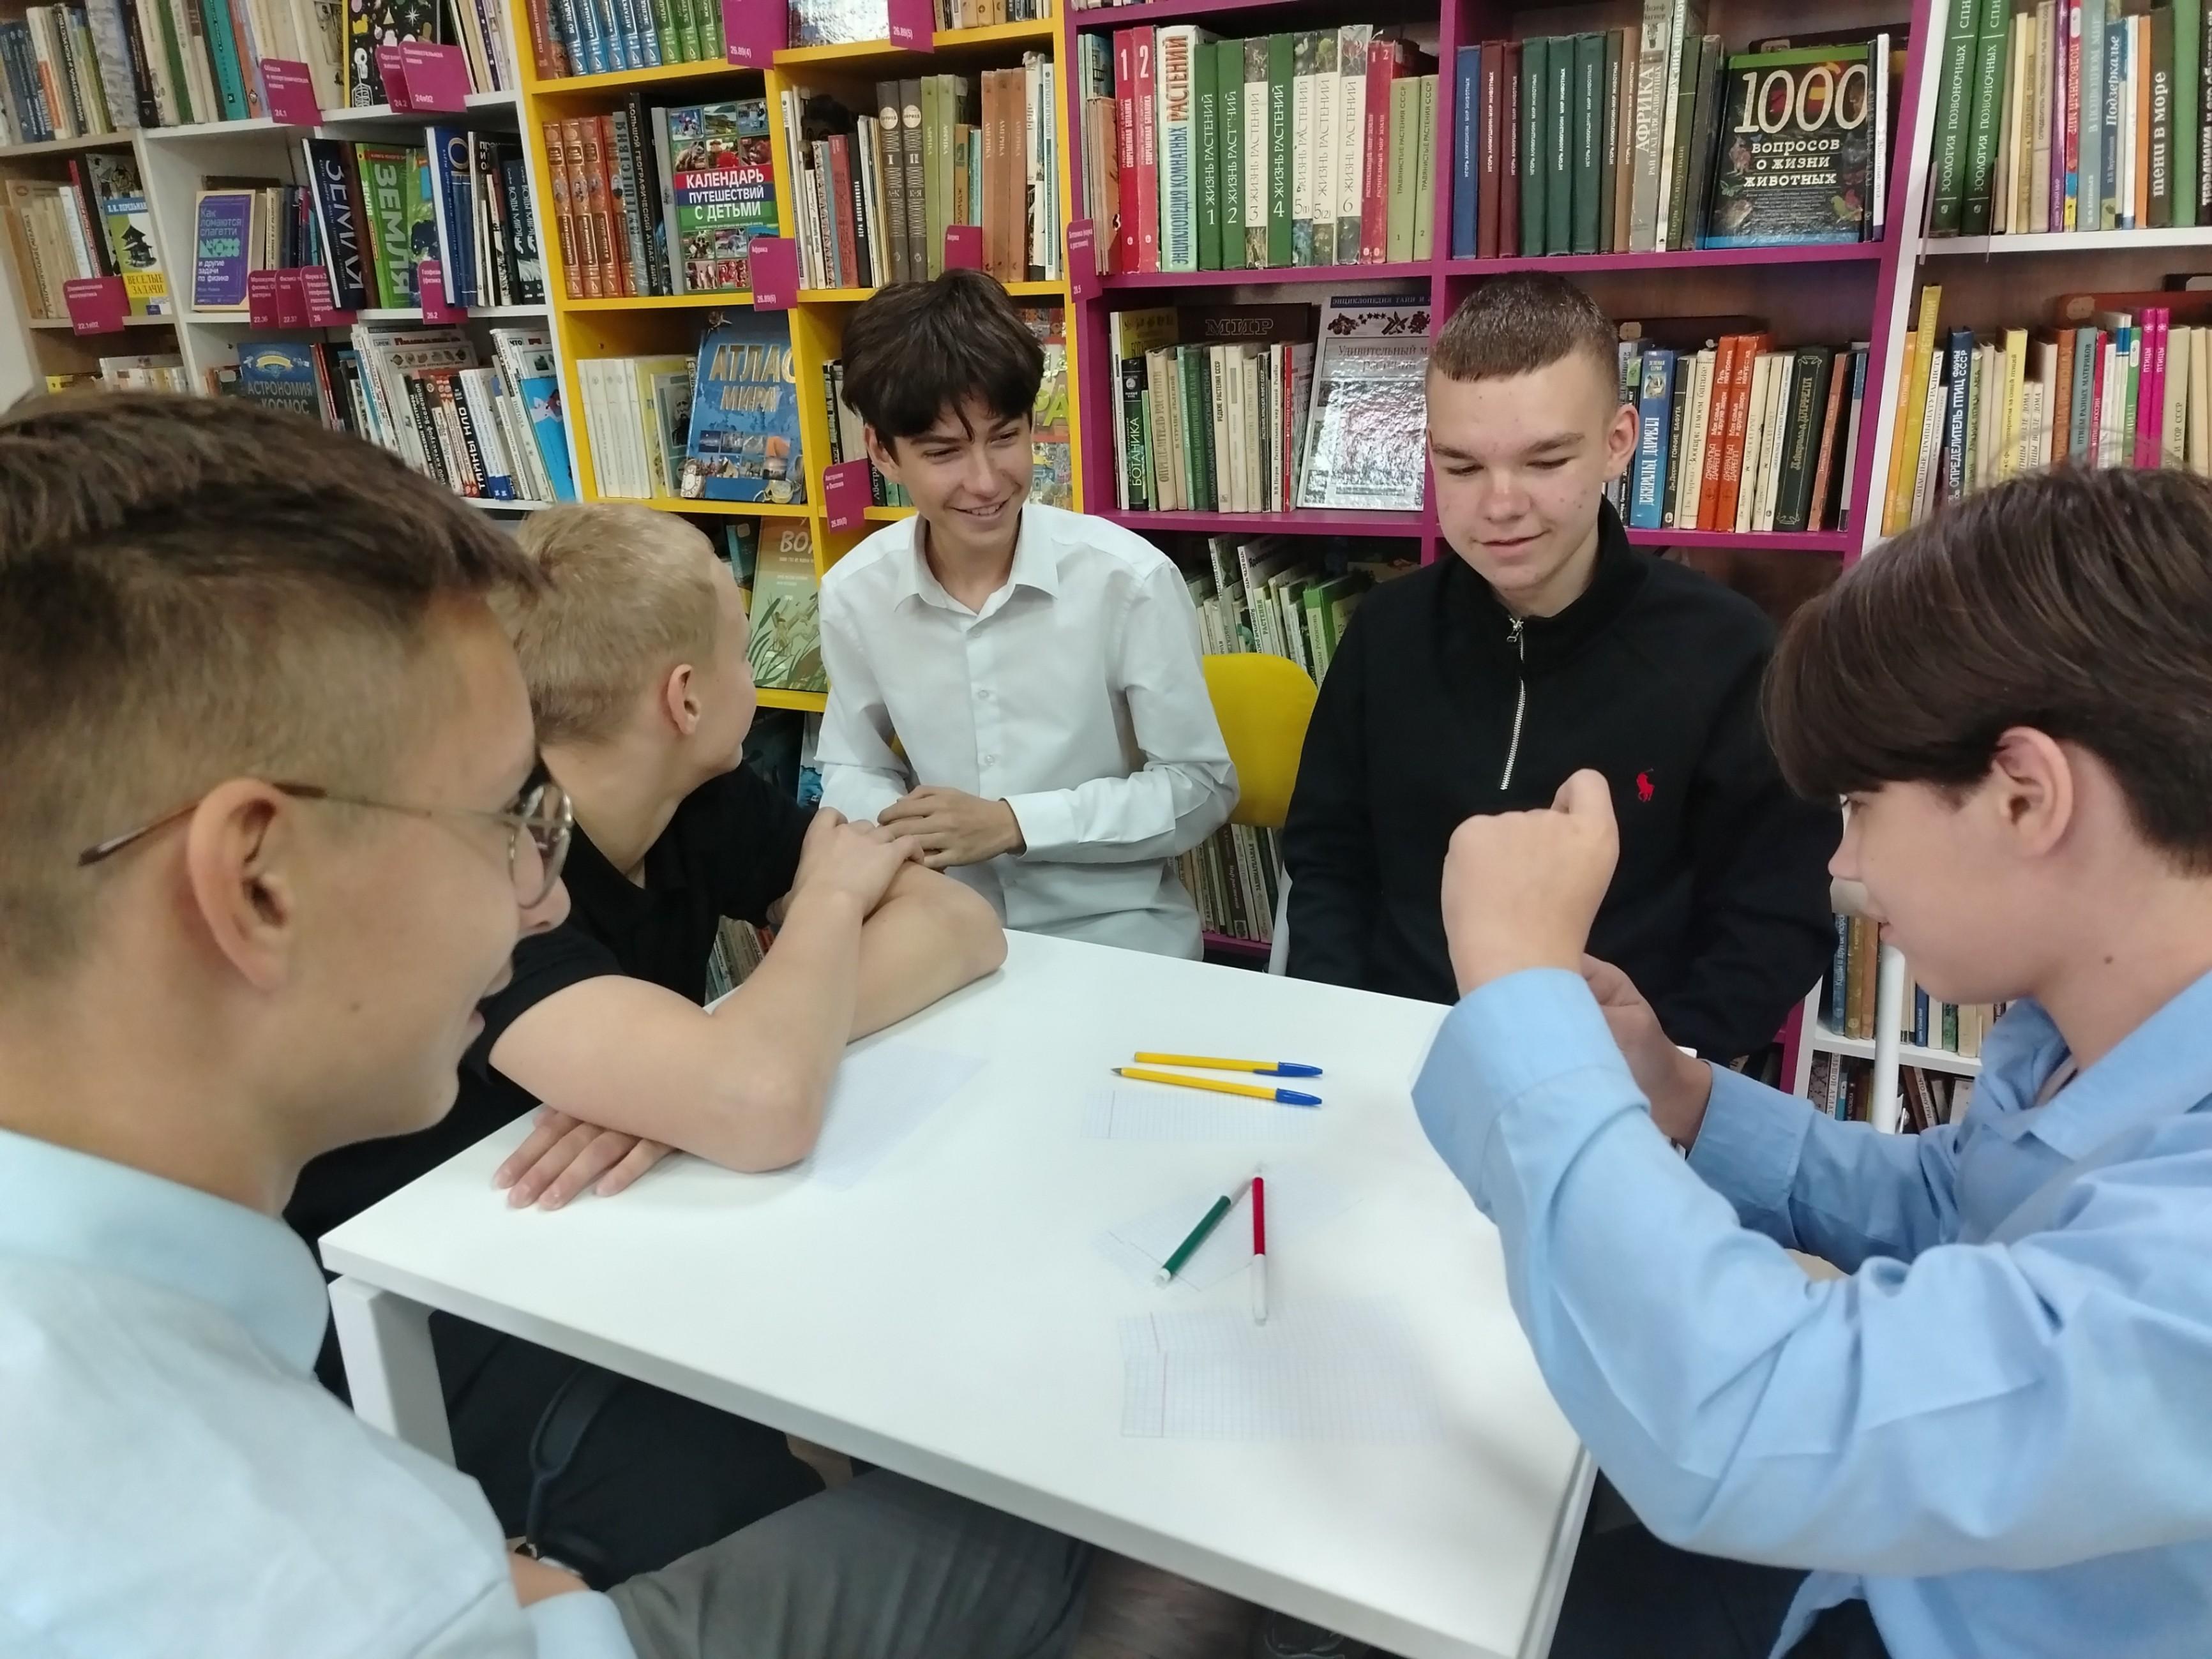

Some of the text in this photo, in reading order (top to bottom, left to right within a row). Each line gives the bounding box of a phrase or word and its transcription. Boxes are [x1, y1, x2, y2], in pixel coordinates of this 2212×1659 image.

[57, 13, 84, 121] МАТЕМАТИКА ИСКУССТВО
[730, 45, 752, 58] 26.89(4)
[1121, 49, 1129, 81] 1
[1140, 45, 1149, 78] 2
[1383, 49, 1389, 59] 2
[1672, 51, 1681, 73] МИР
[2068, 43, 2080, 112] ПОДВОДНЫЙ
[2105, 36, 2119, 126] Подзеркалье
[274, 109, 288, 117] 24.1
[393, 99, 408, 108] 24.2
[1318, 79, 1330, 148] РАСТЕНИЙ
[1346, 82, 1357, 146] РАСТЕНИЙ
[1636, 66, 1654, 153] АФРИКА
[1734, 64, 1867, 133] 1000
[1143, 94, 1153, 165] СОВРЕМЕННАЯ БОТАНИКА
[1941, 44, 1966, 192] ЗООЛОГИЯ ПОЗВОНОЧНЫХ
[1974, 44, 1997, 191] ЗООЛОГИЯ ПОЗВОНОЧНЫХ
[1125, 128, 1134, 168] СОВРЕМЕННАЯ
[1162, 36, 1193, 265] ЭНЦИКЛОПЕДИЯ КОМНАТНЫХ РАСТЕНИЙ
[1201, 94, 1216, 225] 1 ЖИЗНЬ РАСТЕНИЙ
[1225, 91, 1237, 224] 2 ЖИЗНЬ РАСТНИЙ
[1247, 93, 1260, 220] 3 ЖИЗНЬ РАСТЕНИЙ
[1272, 84, 1285, 217] 4 ЖИЗНЬ РАСТЕНИЙ
[629, 103, 641, 147] БОЛЬШОЙ
[635, 151, 651, 231] ГЕОГРАФИЧЕСКИЙ
[646, 234, 655, 262] АТЛАС
[686, 169, 764, 189] КАЛЕНДАРЬ
[1318, 152, 1328, 197] ЖИЗНЬ
[1397, 146, 1405, 195] ТРАВЯНИСТЫЕ
[1421, 142, 1429, 191] ТРАВЯНИСТЫЕ
[361, 181, 373, 216] ЗЕМЛЯ
[508, 186, 522, 211] ВОДЫ
[521, 185, 533, 209] ВОДЫ
[689, 185, 764, 204] ПУТЕШЕСТВИЙ
[695, 201, 761, 222] С ДЕТЬМИ
[1343, 197, 1353, 213] 6
[200, 207, 216, 218] Как
[200, 218, 241, 227] ломаются
[375, 164, 409, 293] ЗЕМЛЯ
[200, 227, 237, 237] спагетти
[751, 245, 769, 253] Африка
[126, 273, 164, 284] ВЕСЕЛЫЕ
[132, 284, 164, 295] ЗАДАЧИ
[426, 312, 438, 320] 26.2
[1205, 319, 1274, 336] МИР
[709, 343, 797, 382] АТЛАС
[1338, 345, 1417, 356] Удивительный
[1959, 350, 1967, 376] СССР
[2082, 344, 2092, 386] МАТЕРИКОВ
[2143, 347, 2151, 372] ПТИЦЫ
[2157, 347, 2165, 372] ПТИЦЫ
[248, 381, 313, 396] АСТРОНОМИЯ
[719, 385, 778, 413] МИРА
[1697, 366, 1707, 398] багаже
[1798, 377, 1812, 421] ДАРРЕЛЛ
[1924, 354, 1941, 421] НАТУРАЛИСТА
[1953, 379, 1966, 408] ПТИЦ
[415, 383, 430, 424] Вселенной
[1696, 401, 1704, 422] моем
[2079, 389, 2088, 417] РАЗНЫХ
[458, 407, 470, 435] НЛО
[1921, 422, 1932, 454] ТРОПЫ
[426, 426, 442, 467] катастроф
[1129, 417, 1142, 485] БОТАНИКА
[1639, 417, 1660, 506] ДЖЕРАЛЬД ДАРРЕЛЛ
[1687, 431, 1701, 465] Зоопарк
[1705, 444, 1716, 480] ДЖЕРАЛЬД
[1949, 410, 1963, 487] ОПРЕДЕЛИТЕЛЬ
[465, 440, 485, 490] ТАЙНЫ
[1915, 456, 1927, 497] ОПАСНЫЕ
[1256, 599, 1268, 634] РАСТЕНИЯ
[1312, 614, 1321, 650] Робинзона
[1921, 1092, 1932, 1118] ВНУТРИ
